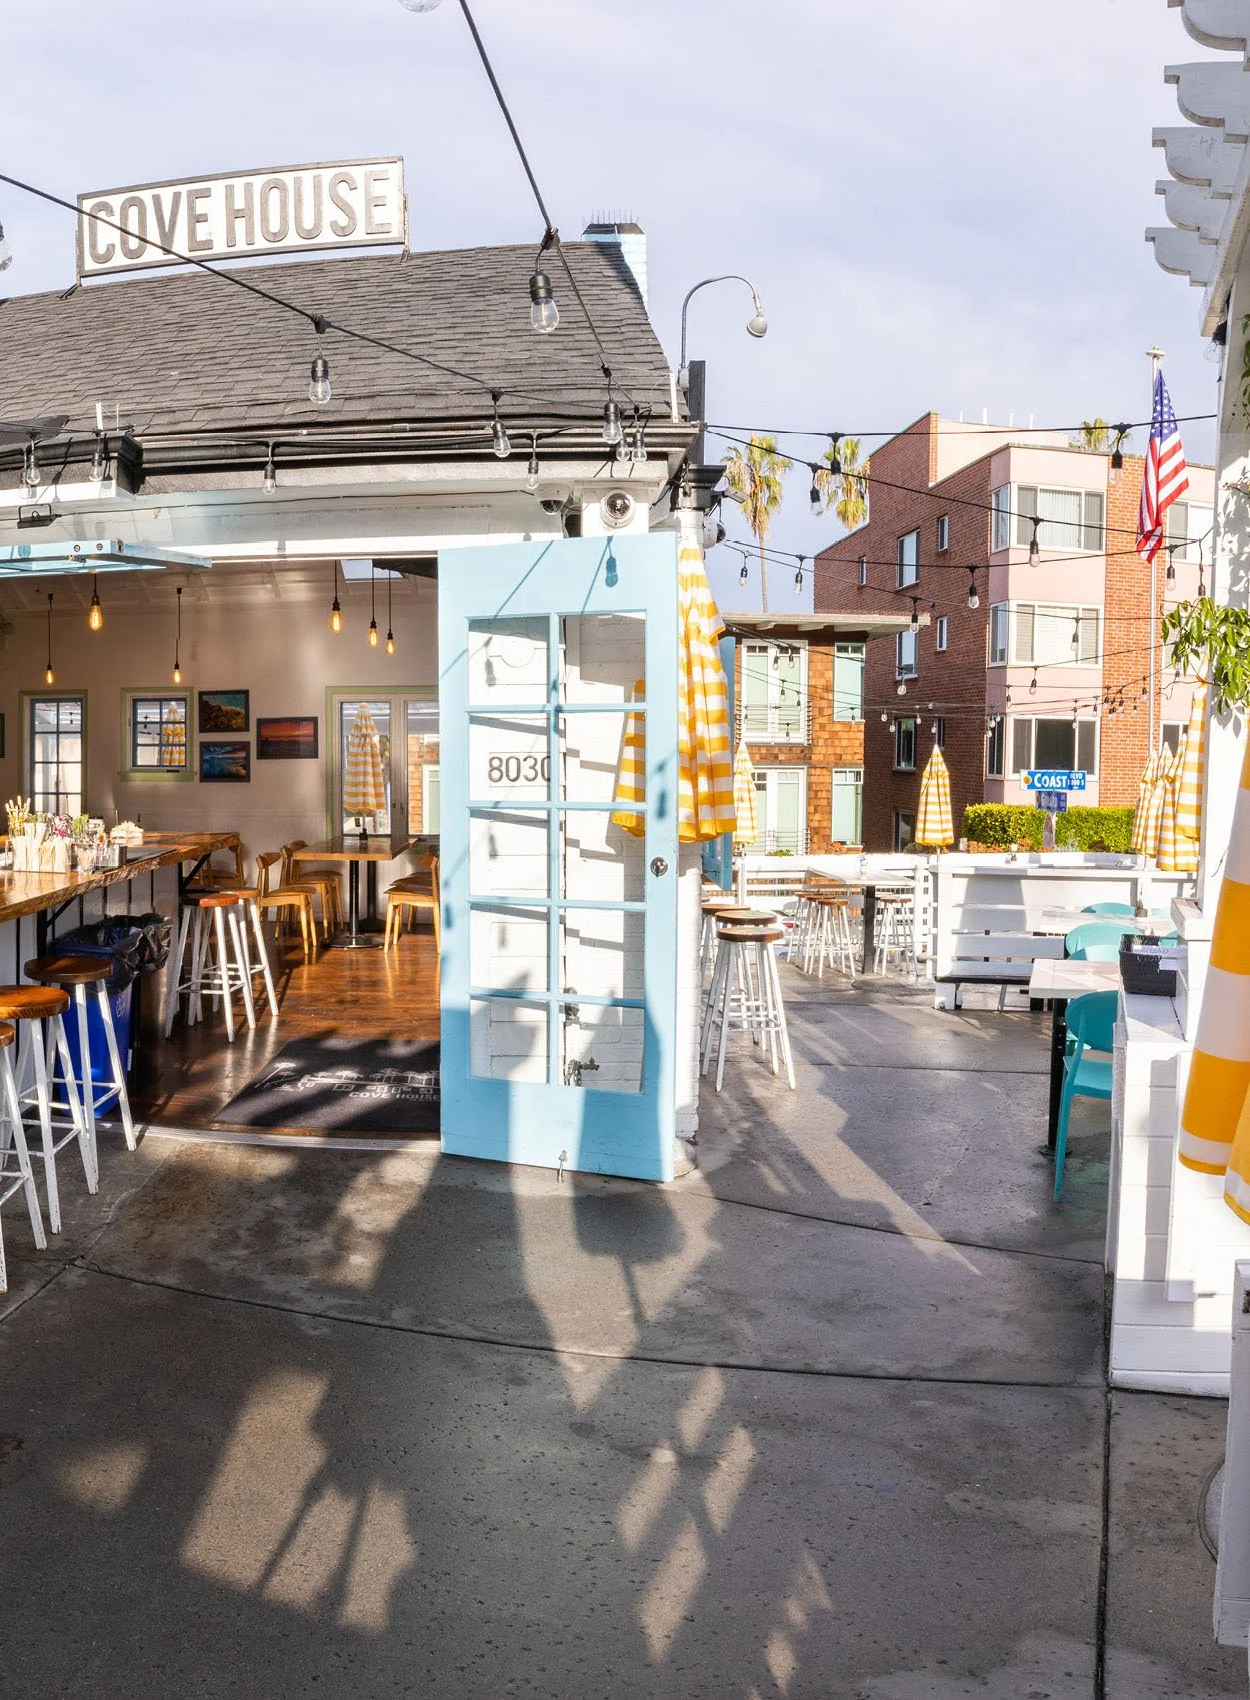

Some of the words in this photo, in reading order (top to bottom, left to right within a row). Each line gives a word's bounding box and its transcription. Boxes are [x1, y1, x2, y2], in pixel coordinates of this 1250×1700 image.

[88, 187, 214, 265] COVE
[224, 169, 393, 248] HOUSE
[1033, 773, 1067, 788] COAST
